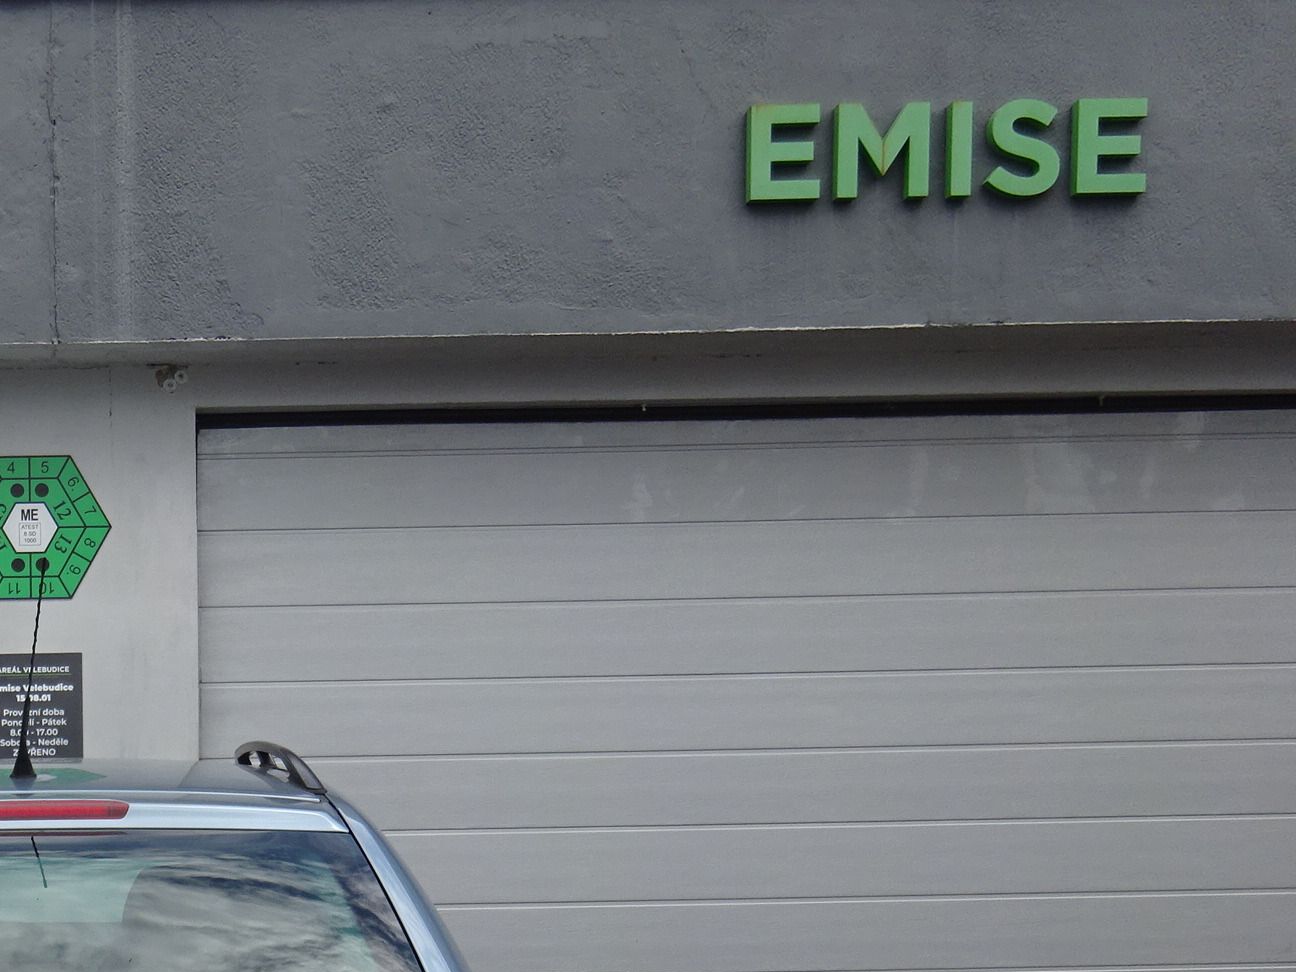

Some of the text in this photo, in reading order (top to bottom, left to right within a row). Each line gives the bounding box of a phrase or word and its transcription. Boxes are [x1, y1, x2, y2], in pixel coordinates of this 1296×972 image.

[745, 96, 1149, 204] EMISE
[7, 462, 16, 473] 4
[41, 461, 49, 473] 5
[20, 509, 39, 521] ME
[52, 500, 72, 521] 12
[84, 506, 97, 515] 7
[53, 533, 73, 554] 13
[83, 537, 96, 549] 8
[7, 583, 21, 594] 11
[22, 683, 74, 692] Velebudice
[15, 694, 52, 703] 1508.01
[3, 708, 65, 717] Provzní doba
[1, 719, 35, 728] Ponlí
[41, 717, 67, 727] Pátek
[36, 728, 59, 736] 17.00
[0, 739, 31, 747] Soboa
[37, 738, 69, 747] Neděle
[12, 748, 56, 757] ZŘENO
